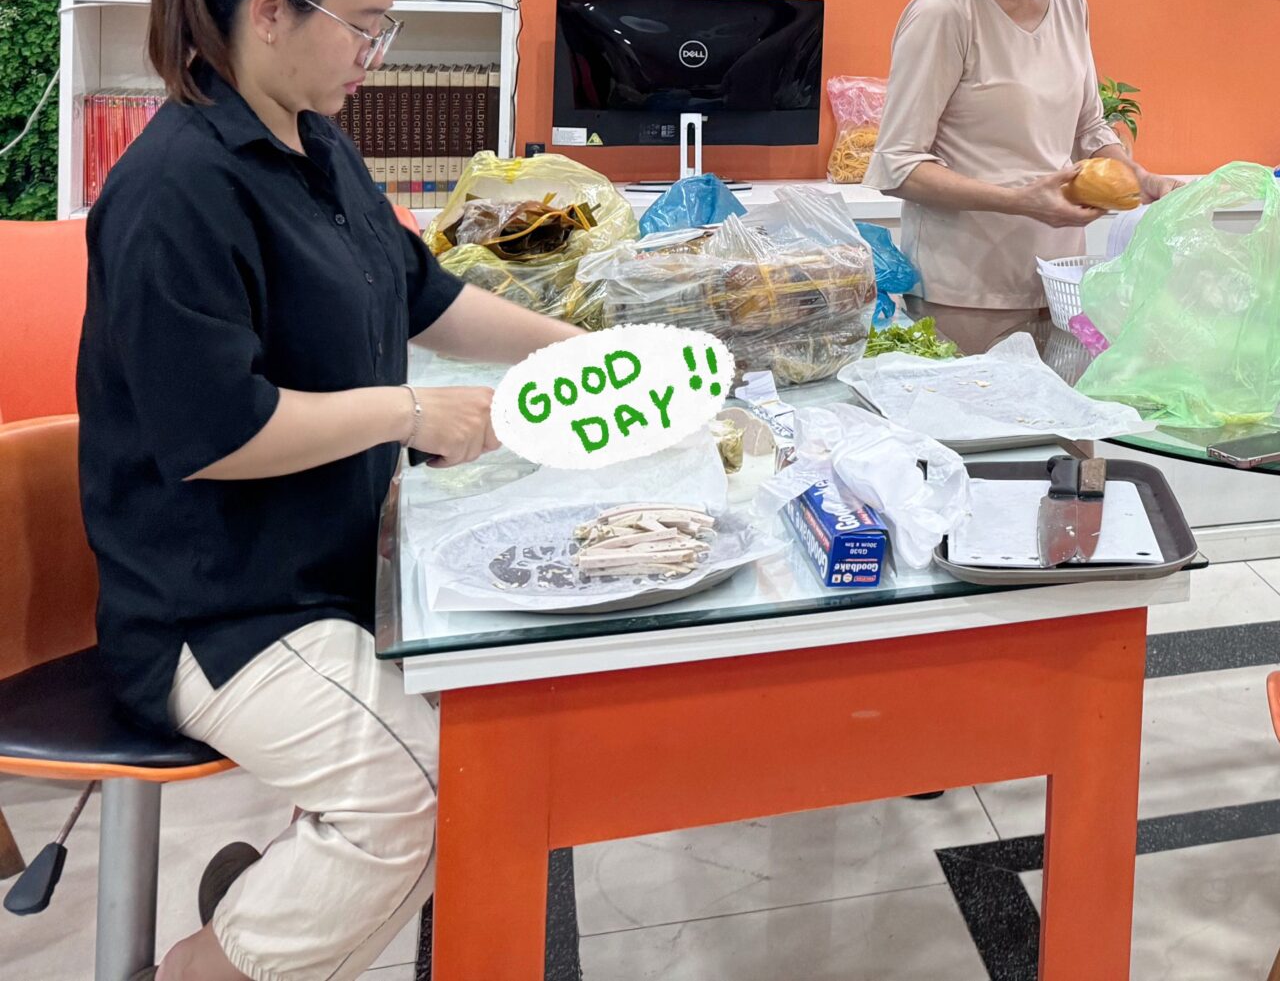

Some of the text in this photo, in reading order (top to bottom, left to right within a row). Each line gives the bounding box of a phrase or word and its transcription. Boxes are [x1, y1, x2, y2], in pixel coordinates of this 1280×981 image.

[682, 50, 705, 58] DELL
[365, 93, 373, 151] CHILDCRAFT
[376, 93, 384, 151] CHILDCRAFT
[413, 93, 421, 151] CHILDCRAFT
[439, 93, 447, 151] CHILDCRAFT
[465, 93, 473, 151] CHILDCRAFT
[834, 563, 879, 573] Goodbake
